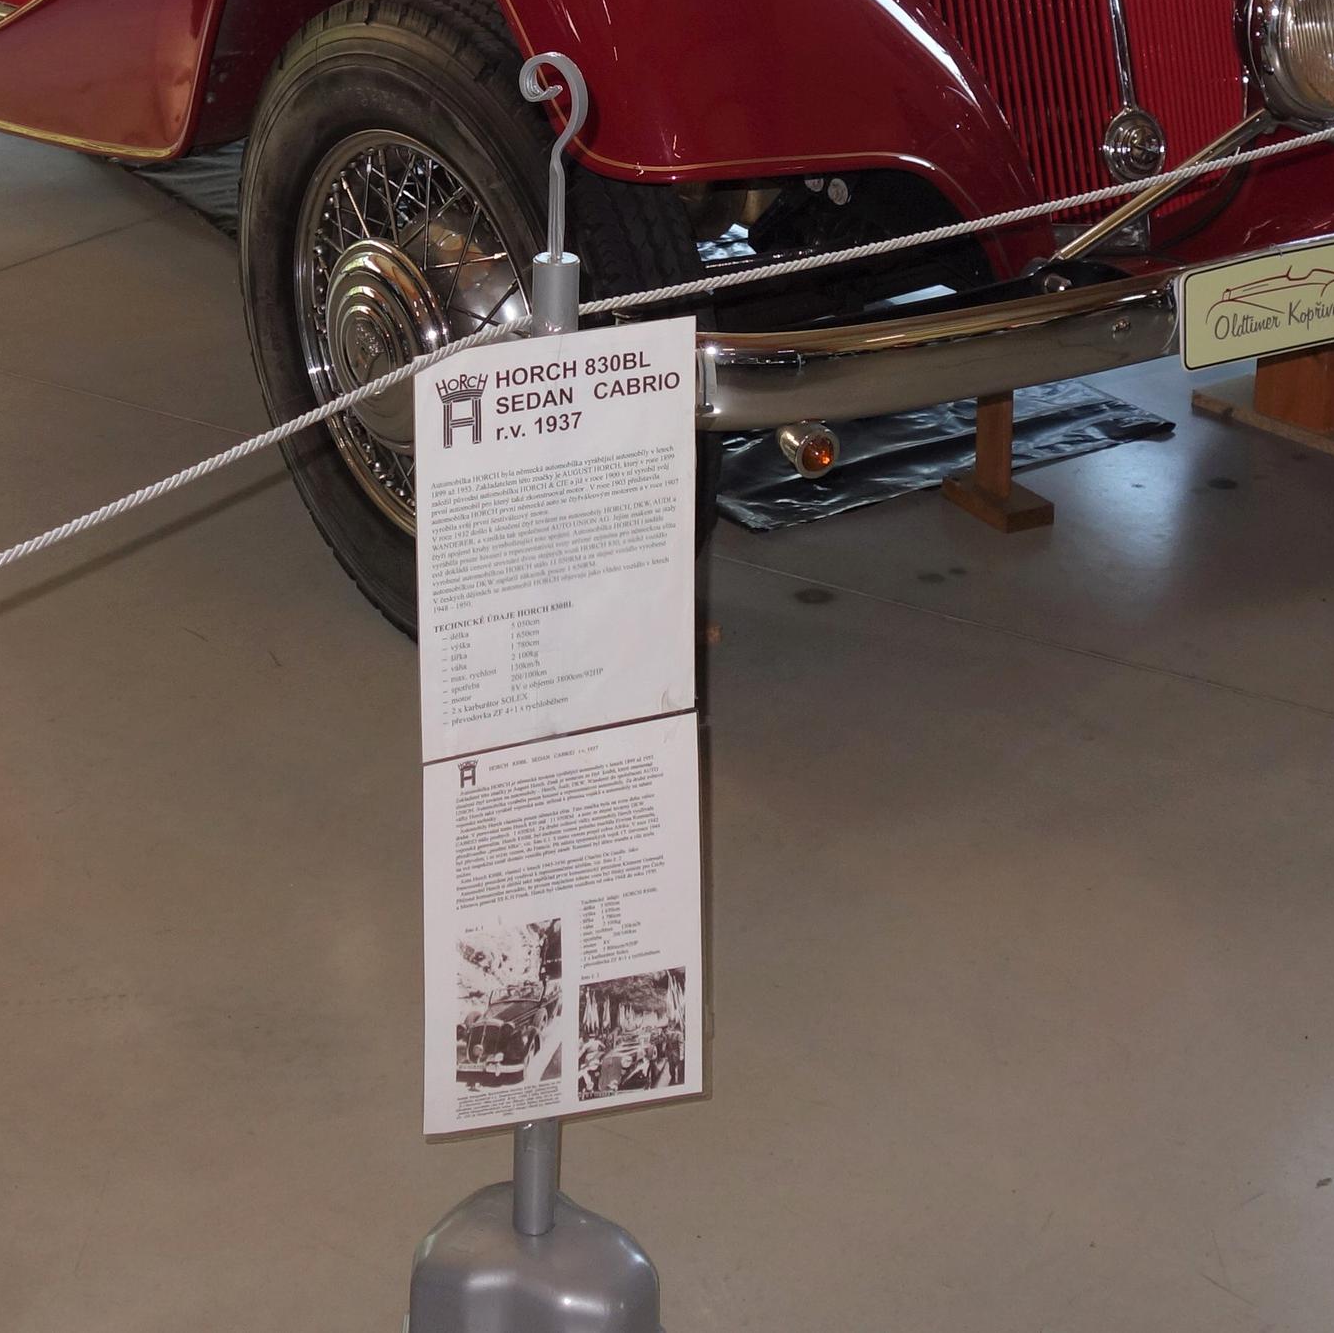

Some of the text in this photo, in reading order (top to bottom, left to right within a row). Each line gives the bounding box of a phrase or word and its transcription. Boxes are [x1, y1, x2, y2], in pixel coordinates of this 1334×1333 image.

[1215, 315, 1281, 340] Oldtimer
[496, 351, 651, 388] HORCH 830BL
[496, 372, 680, 414] SEDAN CABRIO
[496, 412, 582, 440] r.v. 1937
